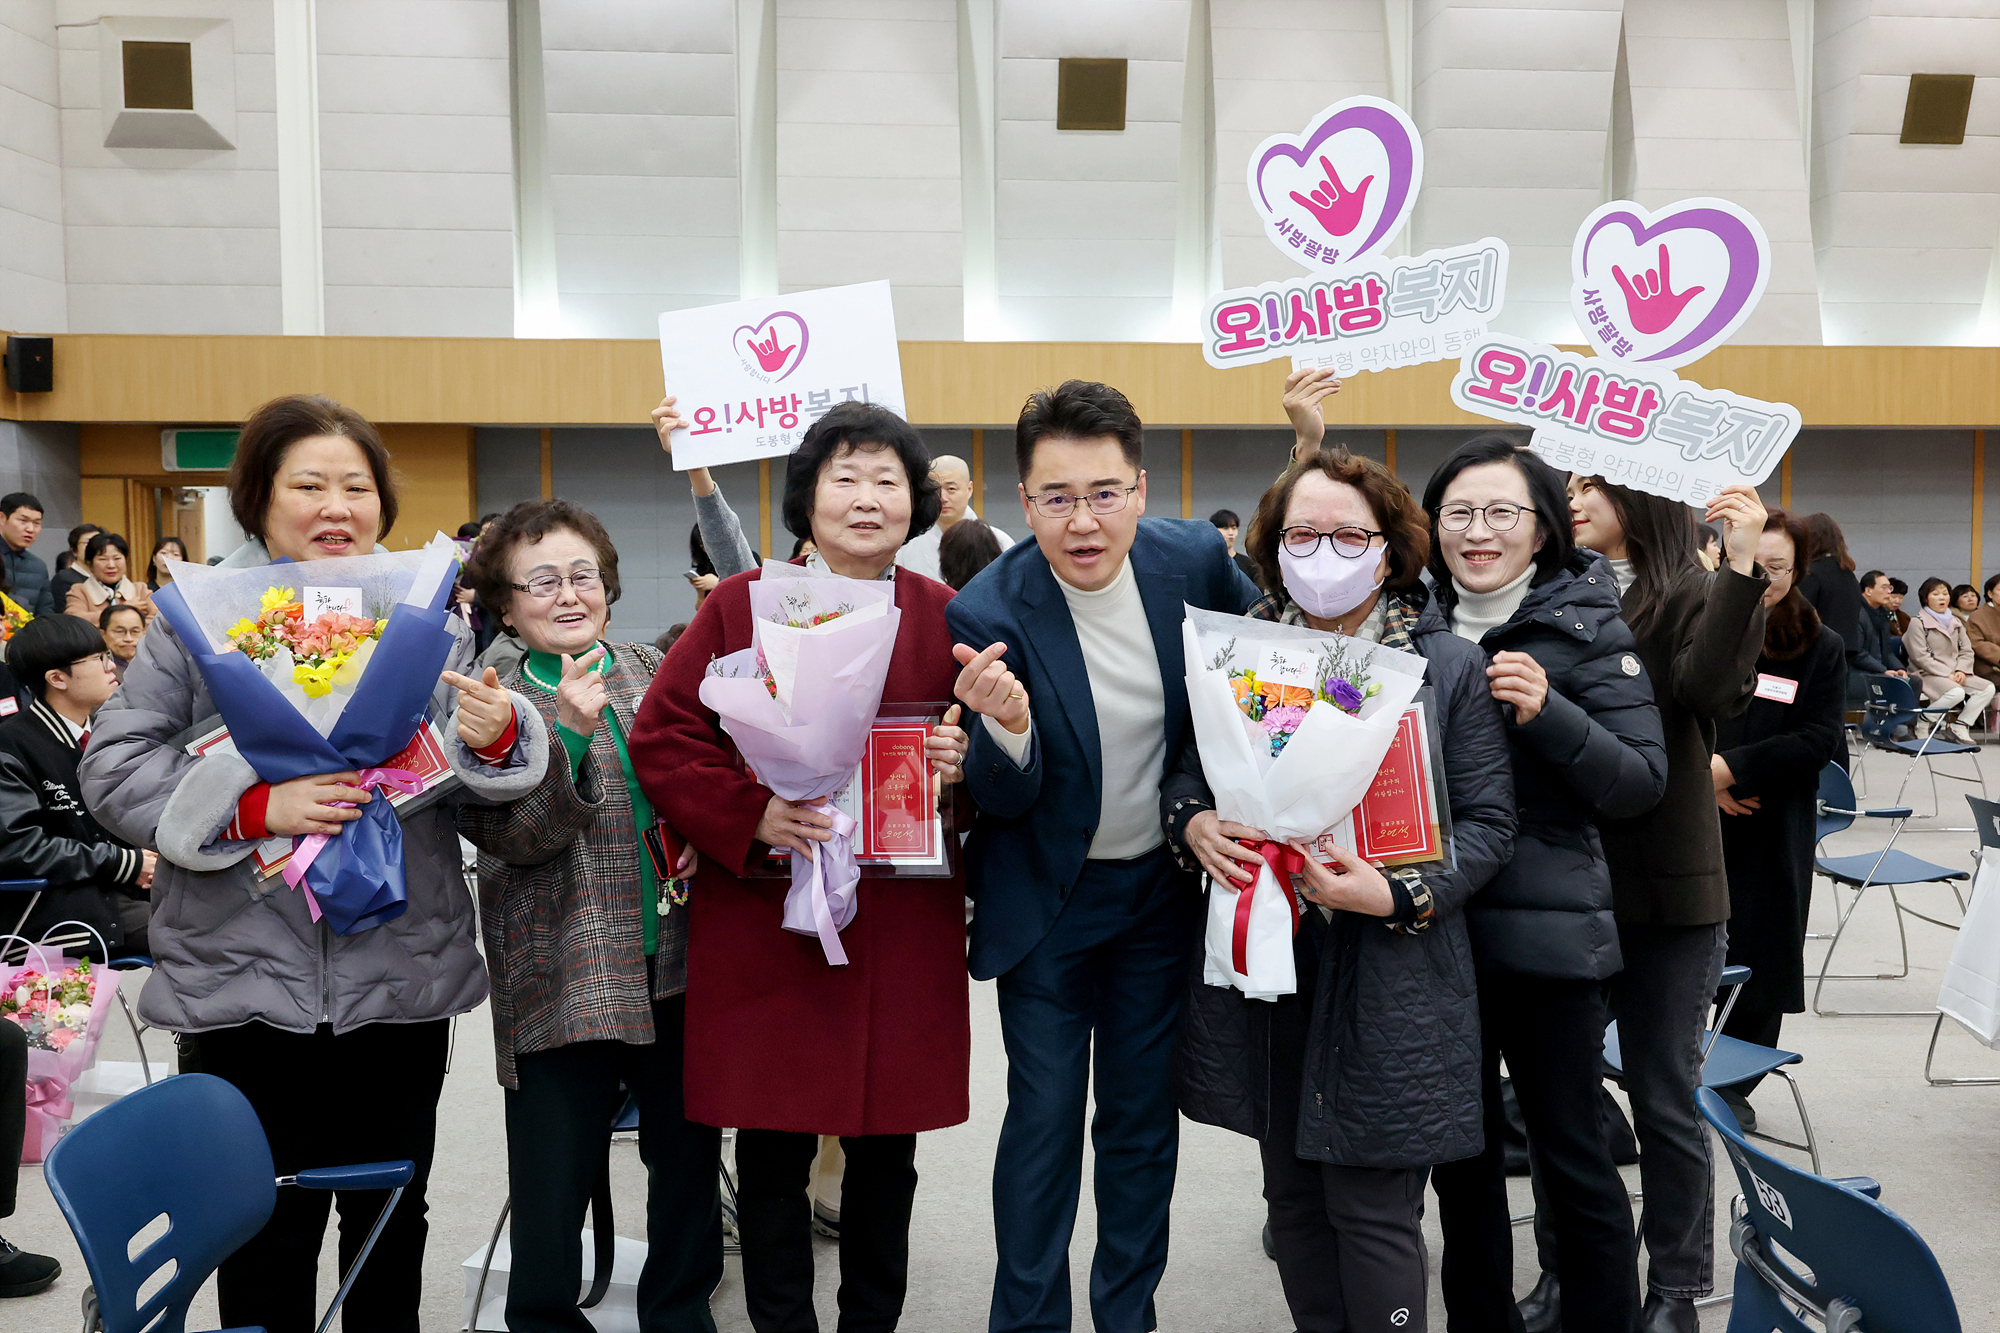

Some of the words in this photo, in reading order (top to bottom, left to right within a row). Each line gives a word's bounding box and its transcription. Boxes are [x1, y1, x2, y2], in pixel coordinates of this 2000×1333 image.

[1274, 217, 1340, 265] 사방팔방
[1582, 288, 1633, 358] 사방팔방
[741, 359, 770, 384] 사랑합니다
[1360, 336, 1436, 366] 약자와의
[756, 433, 791, 447] 도봉형
[1537, 436, 1596, 469] 도봉형
[1603, 454, 1685, 494] 약자와의
[1690, 478, 1723, 501] 동
[1755, 1176, 1786, 1221] 53
